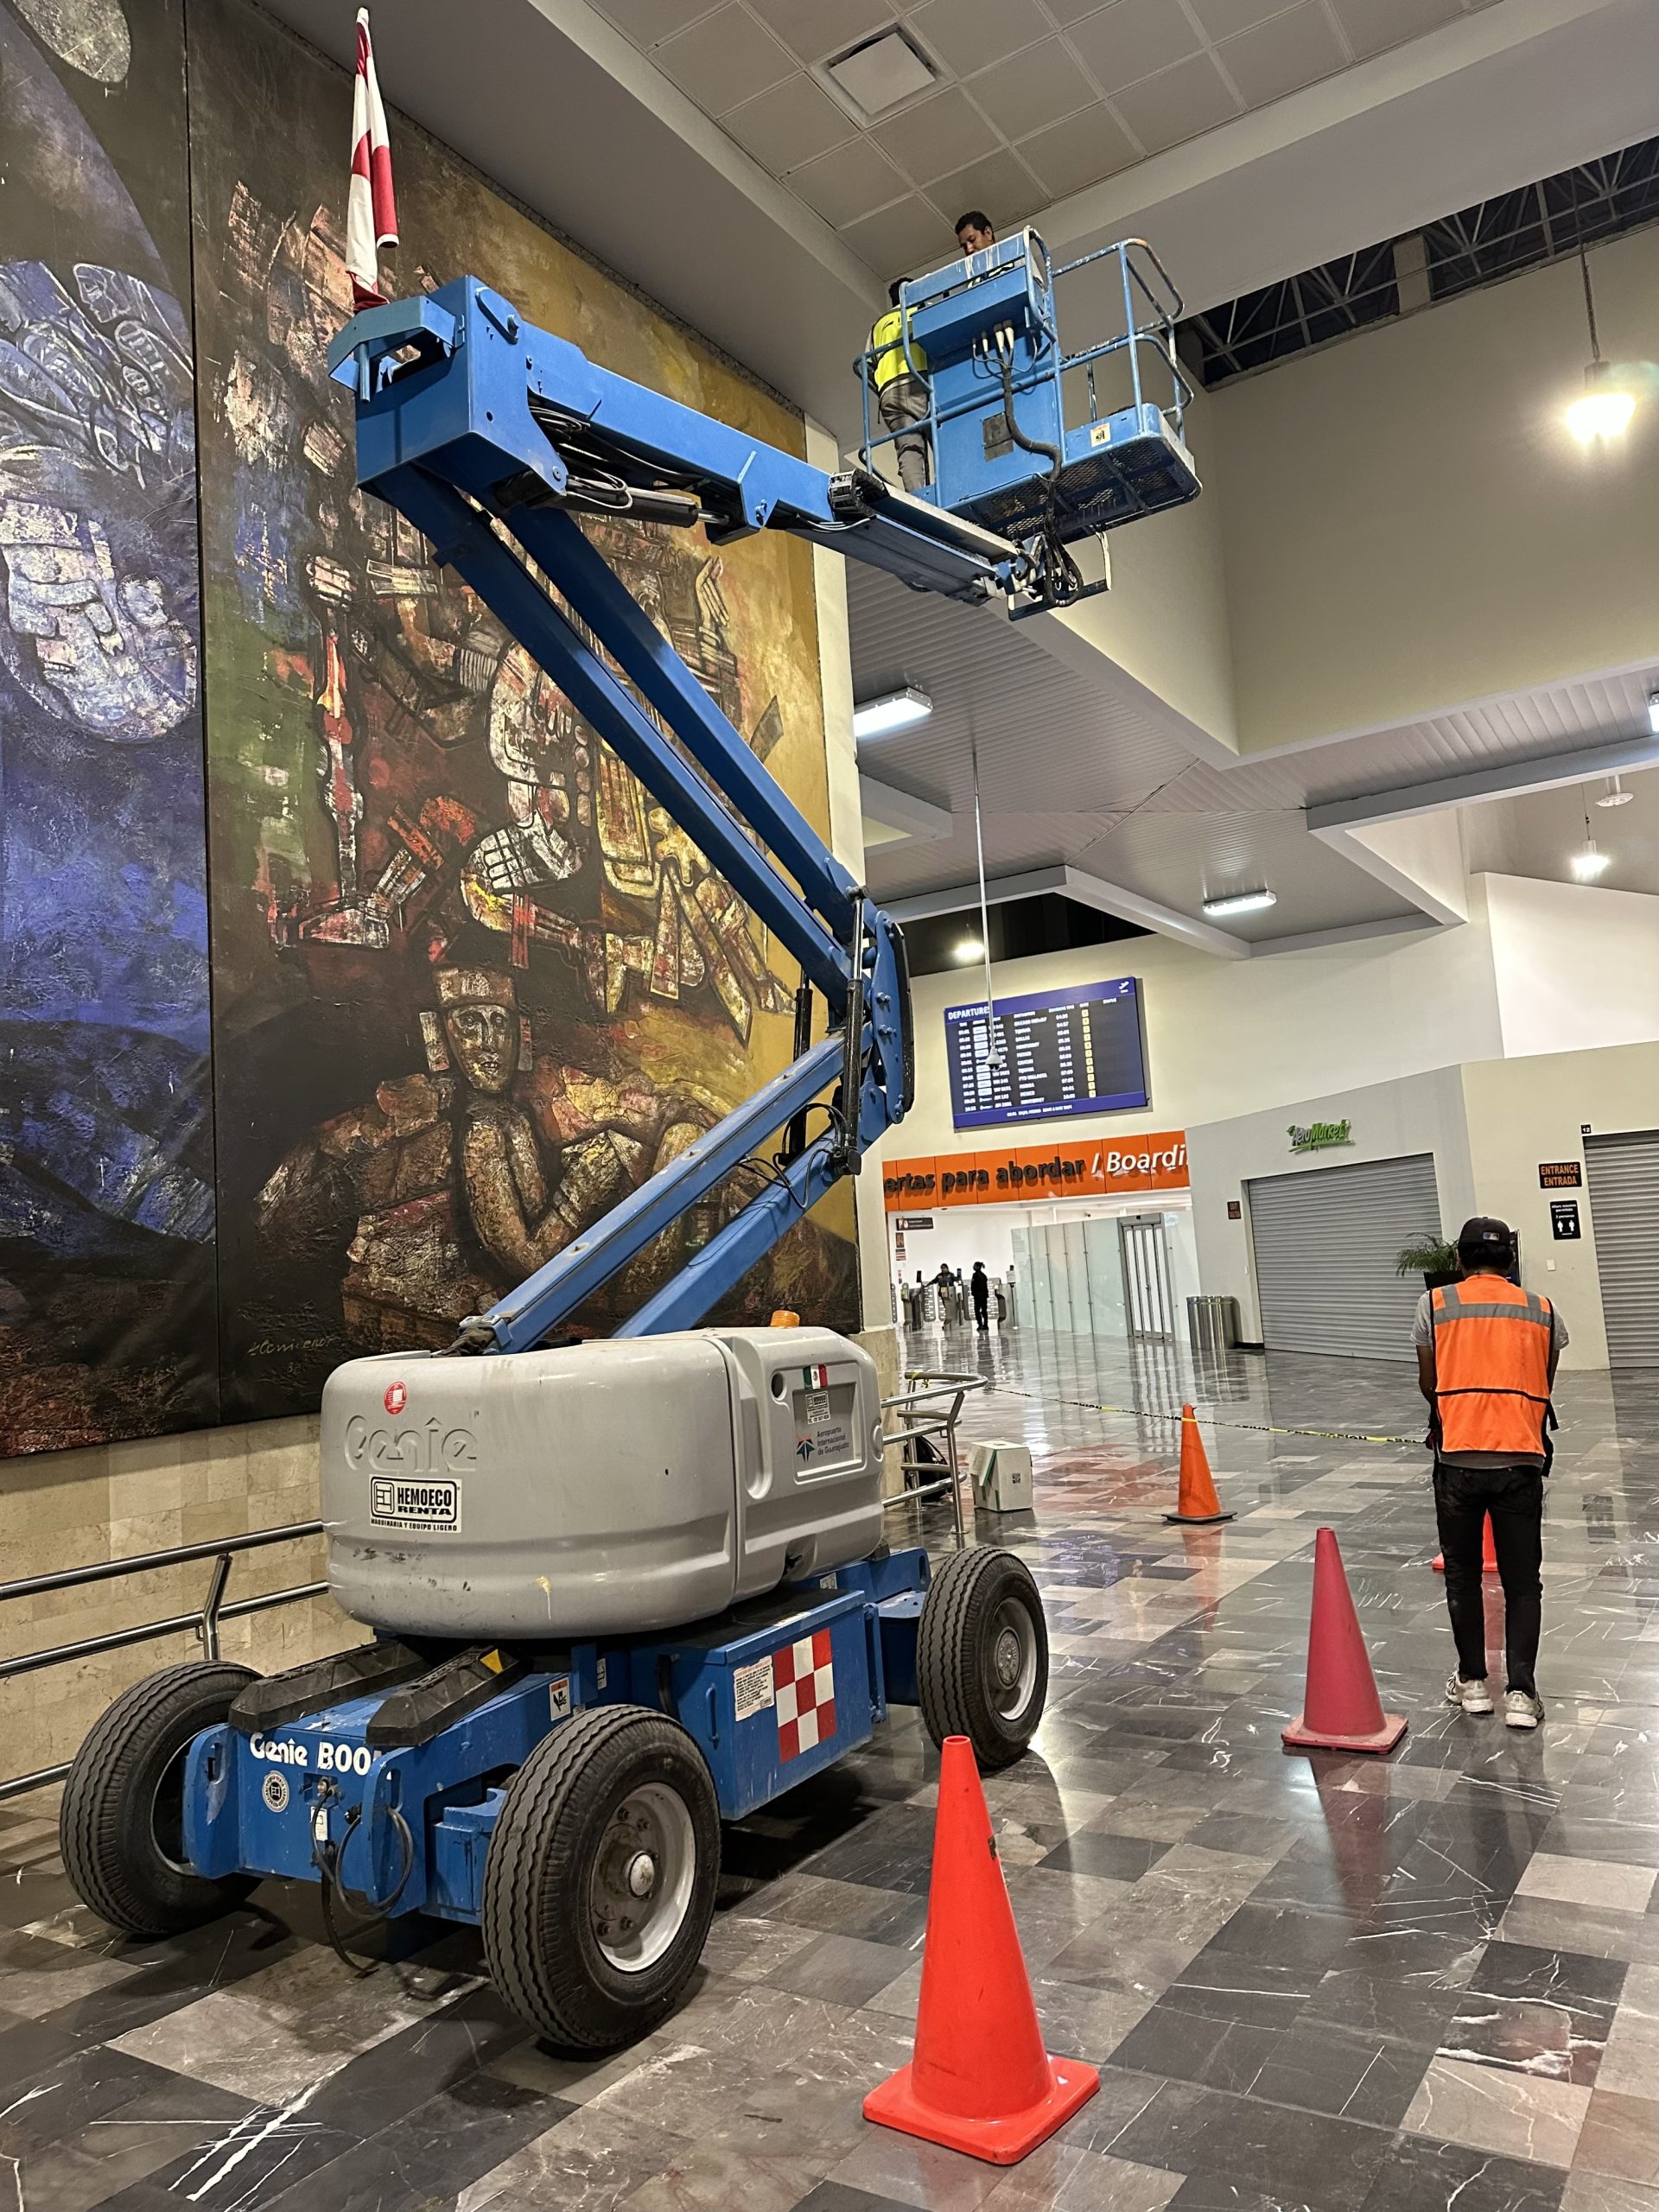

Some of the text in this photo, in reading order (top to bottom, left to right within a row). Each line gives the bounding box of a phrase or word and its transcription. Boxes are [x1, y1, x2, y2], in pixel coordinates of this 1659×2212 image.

[942, 1167, 989, 1193] para
[996, 1156, 1085, 1184] abordar
[1106, 1144, 1189, 1173] Boardi
[1541, 1164, 1580, 1175] ENTRANCE
[1544, 1175, 1578, 1186] ENTRADA
[817, 1427, 842, 1437] Aeropuerto
[345, 1414, 478, 1472] Genie
[817, 1434, 846, 1446] Internacional
[397, 1487, 452, 1507] HEMOECO
[397, 1505, 452, 1516] RENTA
[371, 1518, 403, 1529] MAQUINARIA
[250, 1732, 385, 1777] Genie BOO
